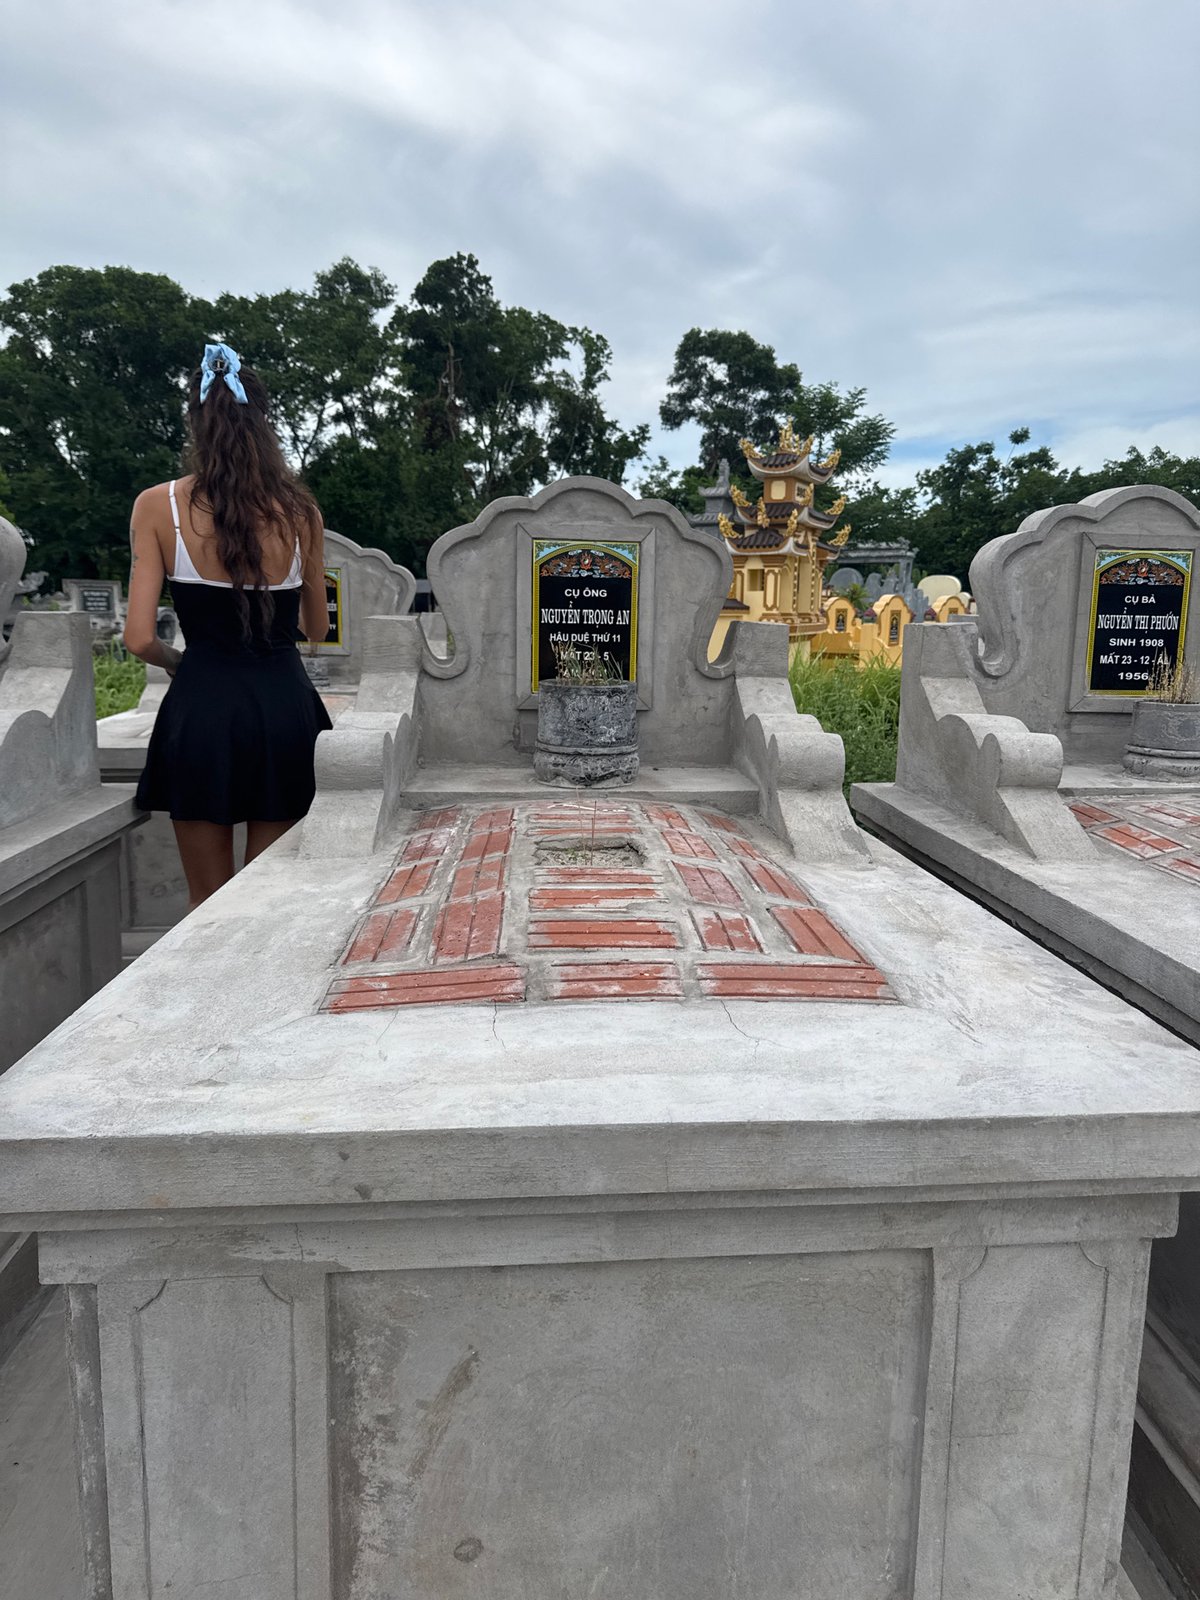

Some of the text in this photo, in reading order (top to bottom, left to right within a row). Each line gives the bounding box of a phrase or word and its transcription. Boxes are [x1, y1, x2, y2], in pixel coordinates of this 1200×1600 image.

[564, 587, 608, 599] CỤ ÔNG
[1124, 595, 1139, 605] CỤ
[582, 609, 615, 629] TRỌNG
[616, 610, 630, 625] AN
[1134, 615, 1149, 634] THỊ
[571, 631, 590, 644] DUỆ
[591, 632, 611, 642] THỨ
[612, 634, 621, 642] 11
[1109, 638, 1164, 647] SINH 1908
[583, 651, 595, 661] 23
[603, 651, 609, 661] 5
[1099, 651, 1120, 664] MẤT
[1121, 655, 1132, 664] 23
[1139, 655, 1150, 664] 12
[1118, 672, 1149, 680] 1956
